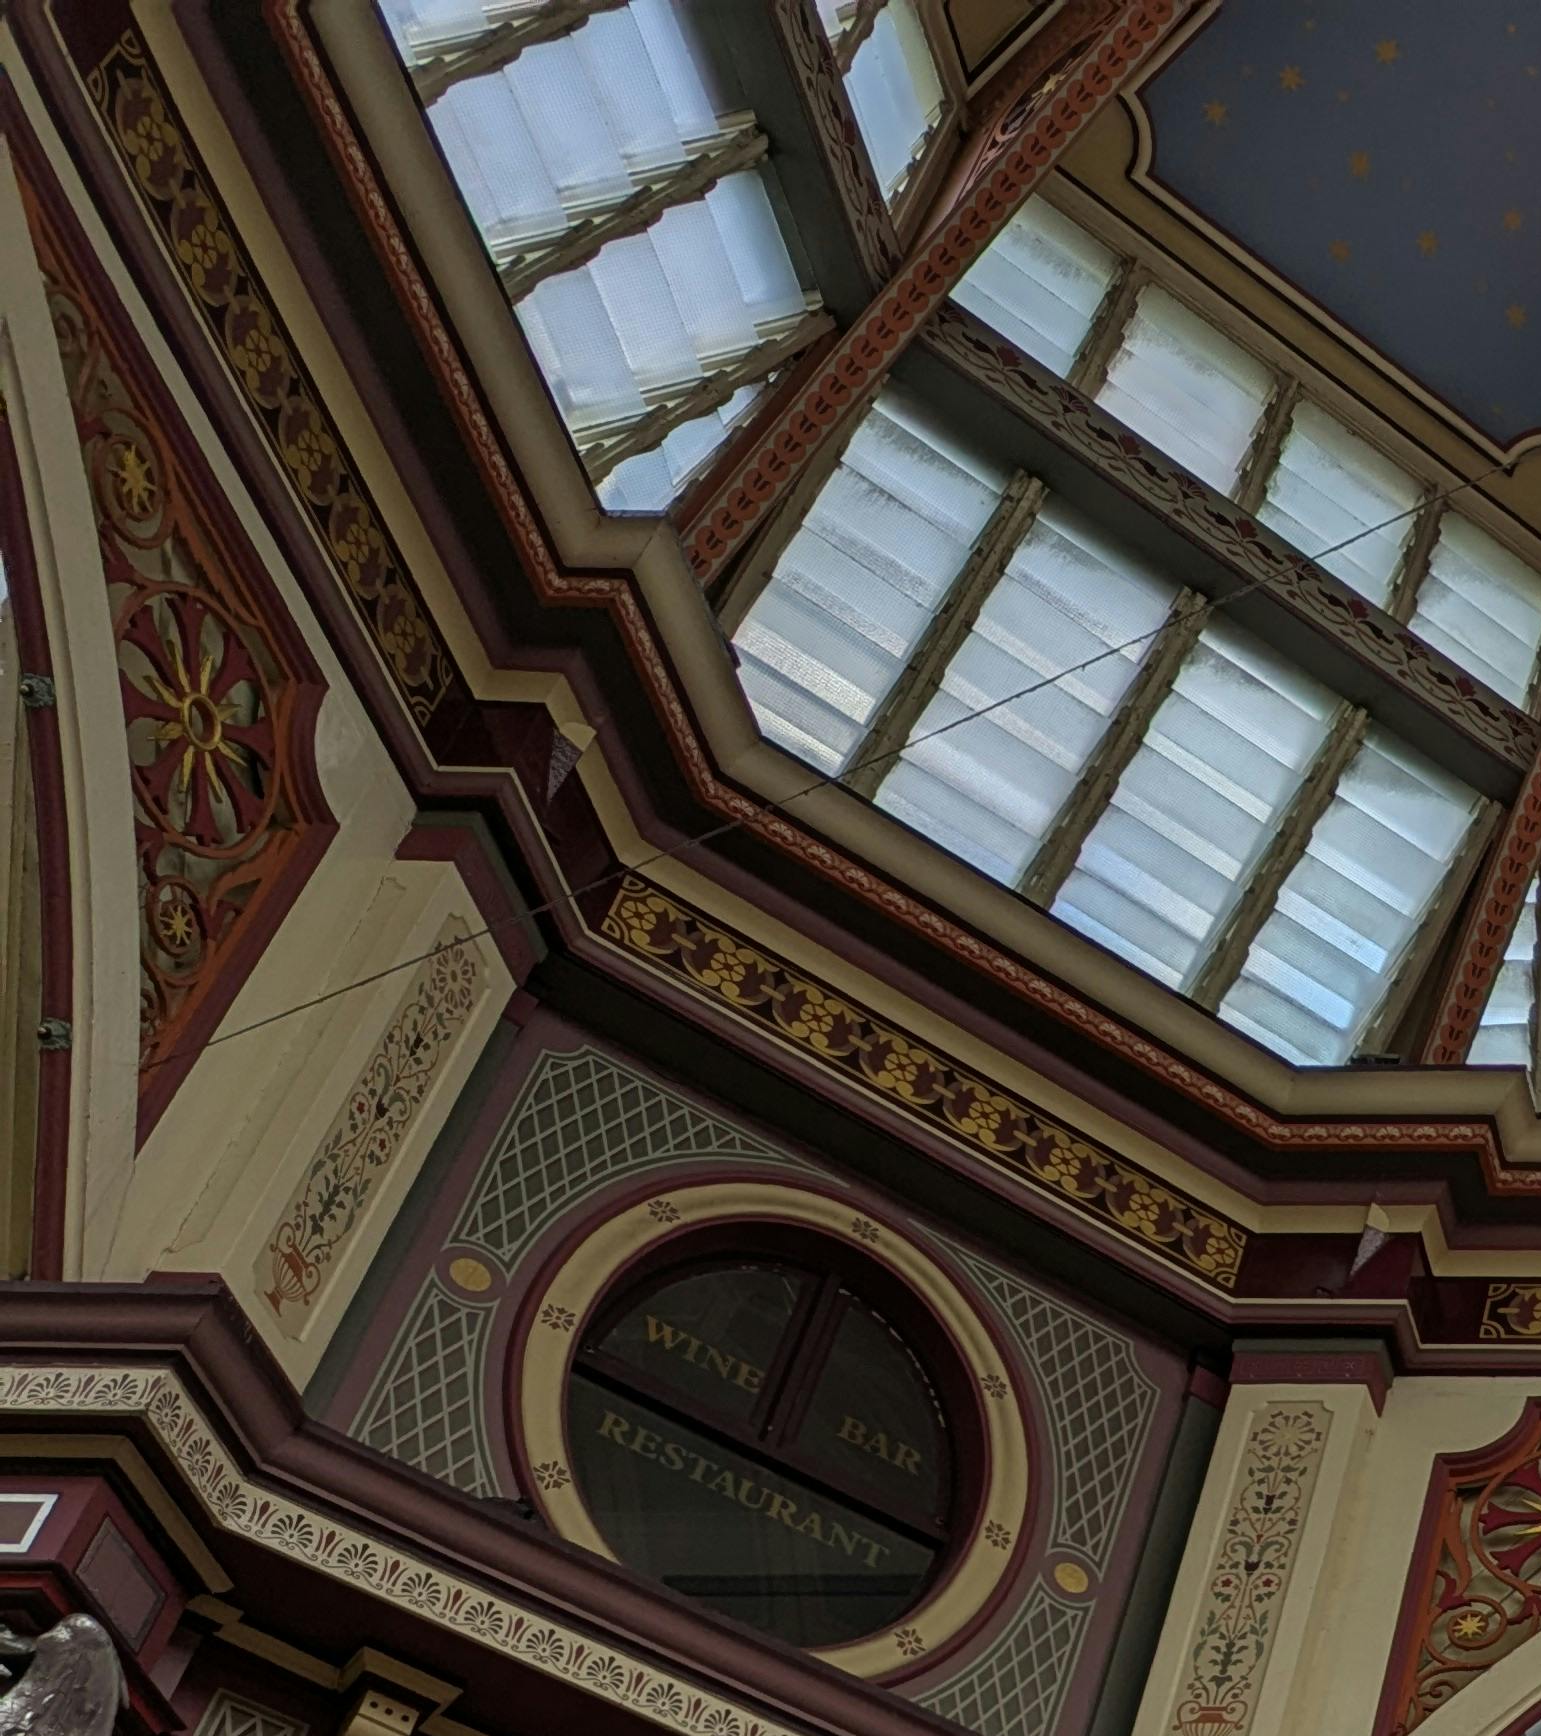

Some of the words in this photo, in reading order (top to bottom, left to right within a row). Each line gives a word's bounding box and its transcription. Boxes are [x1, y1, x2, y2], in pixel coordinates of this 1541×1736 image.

[644, 1314, 764, 1394] WINE
[836, 1414, 924, 1476] BAR
[597, 1409, 890, 1569] RESTAURANT
